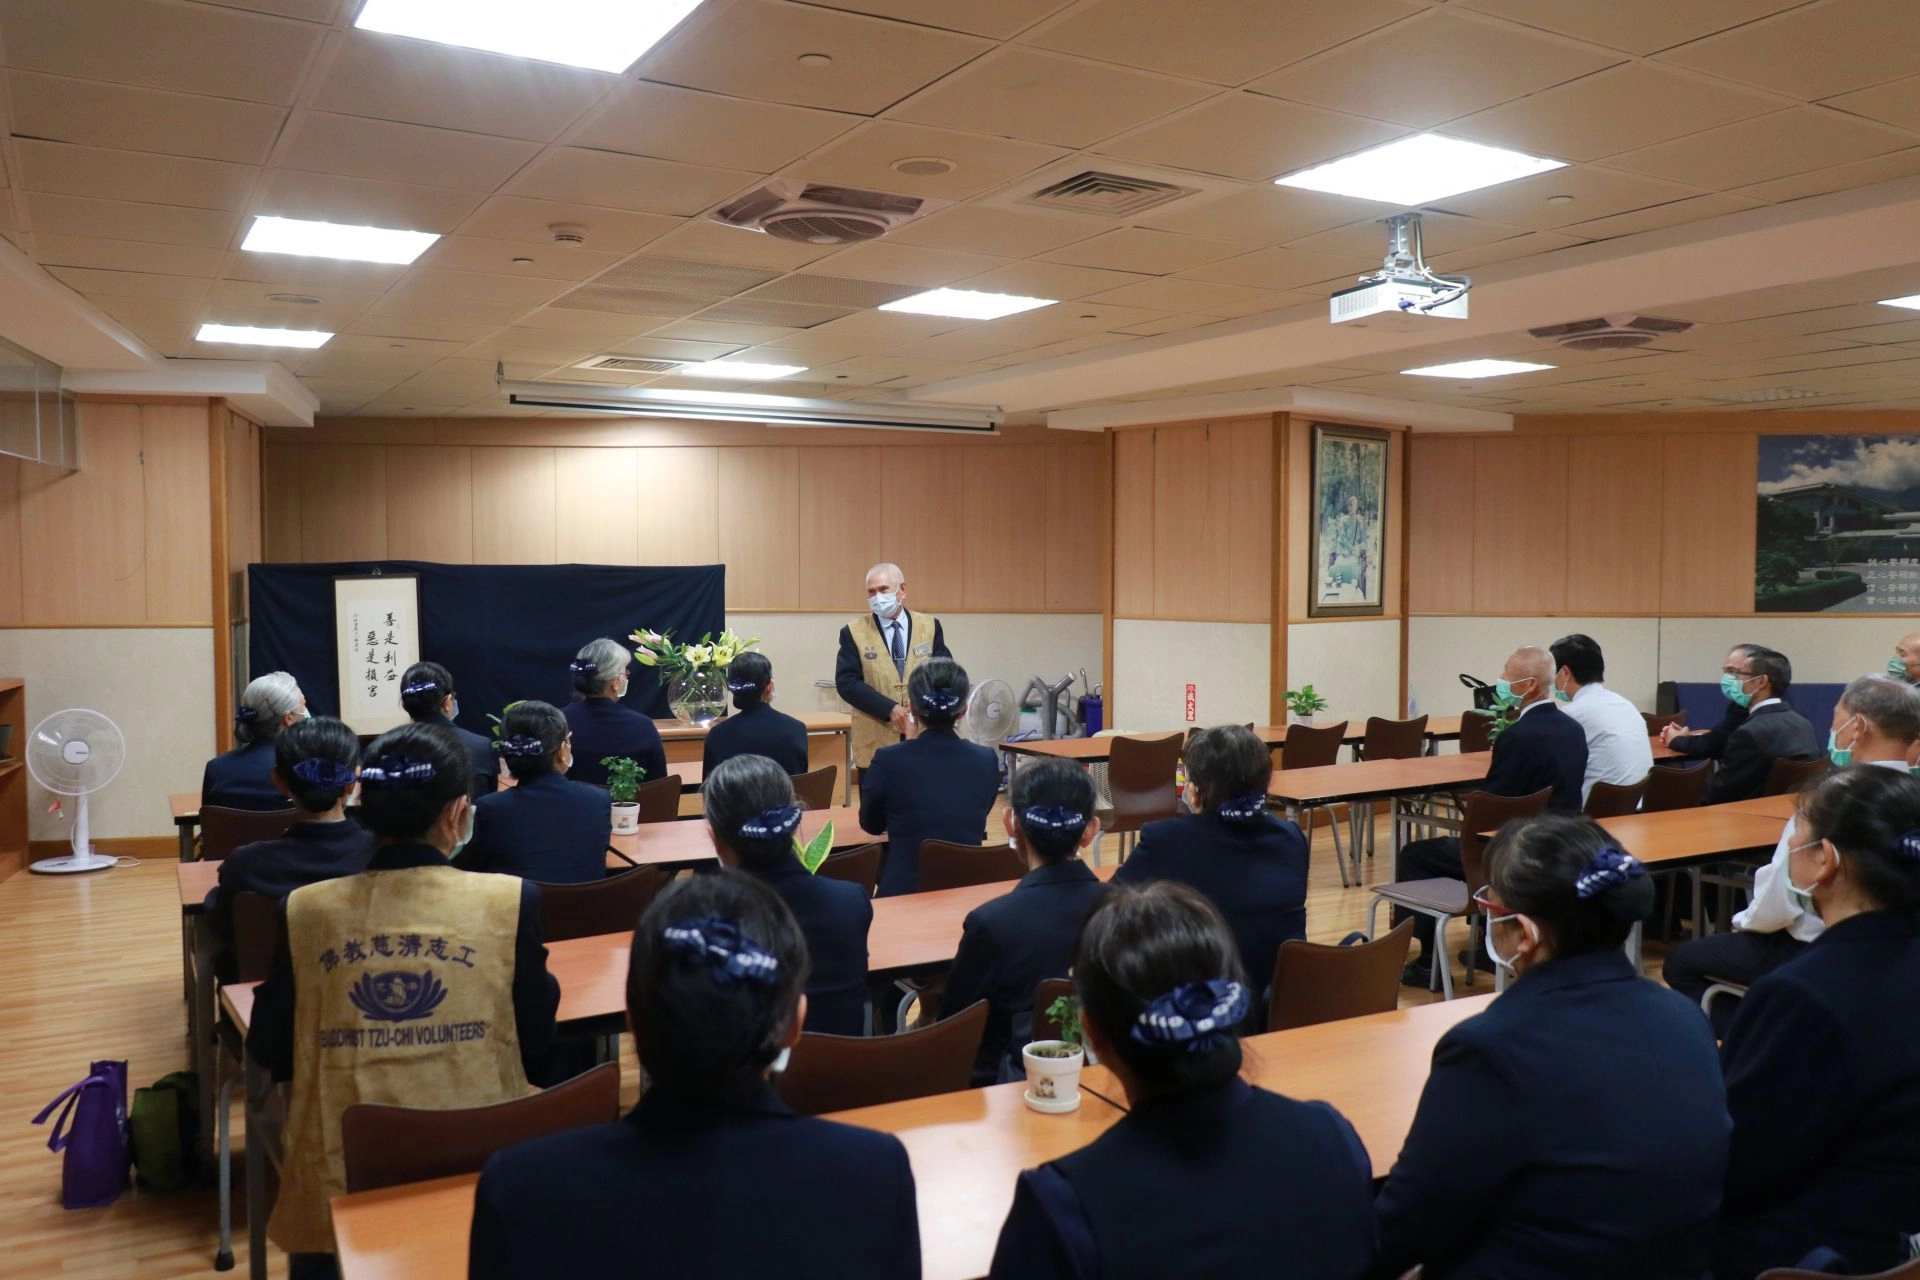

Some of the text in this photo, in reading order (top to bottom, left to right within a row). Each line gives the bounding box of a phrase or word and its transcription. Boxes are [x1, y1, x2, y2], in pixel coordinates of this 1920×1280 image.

[365, 630, 380, 698] 惡是損害
[384, 611, 398, 681] 善是利益
[320, 934, 476, 973] 佛教慈濟志工
[368, 1026, 414, 1047] TZU-CHI
[417, 1021, 486, 1045] VOLUNTEERS
